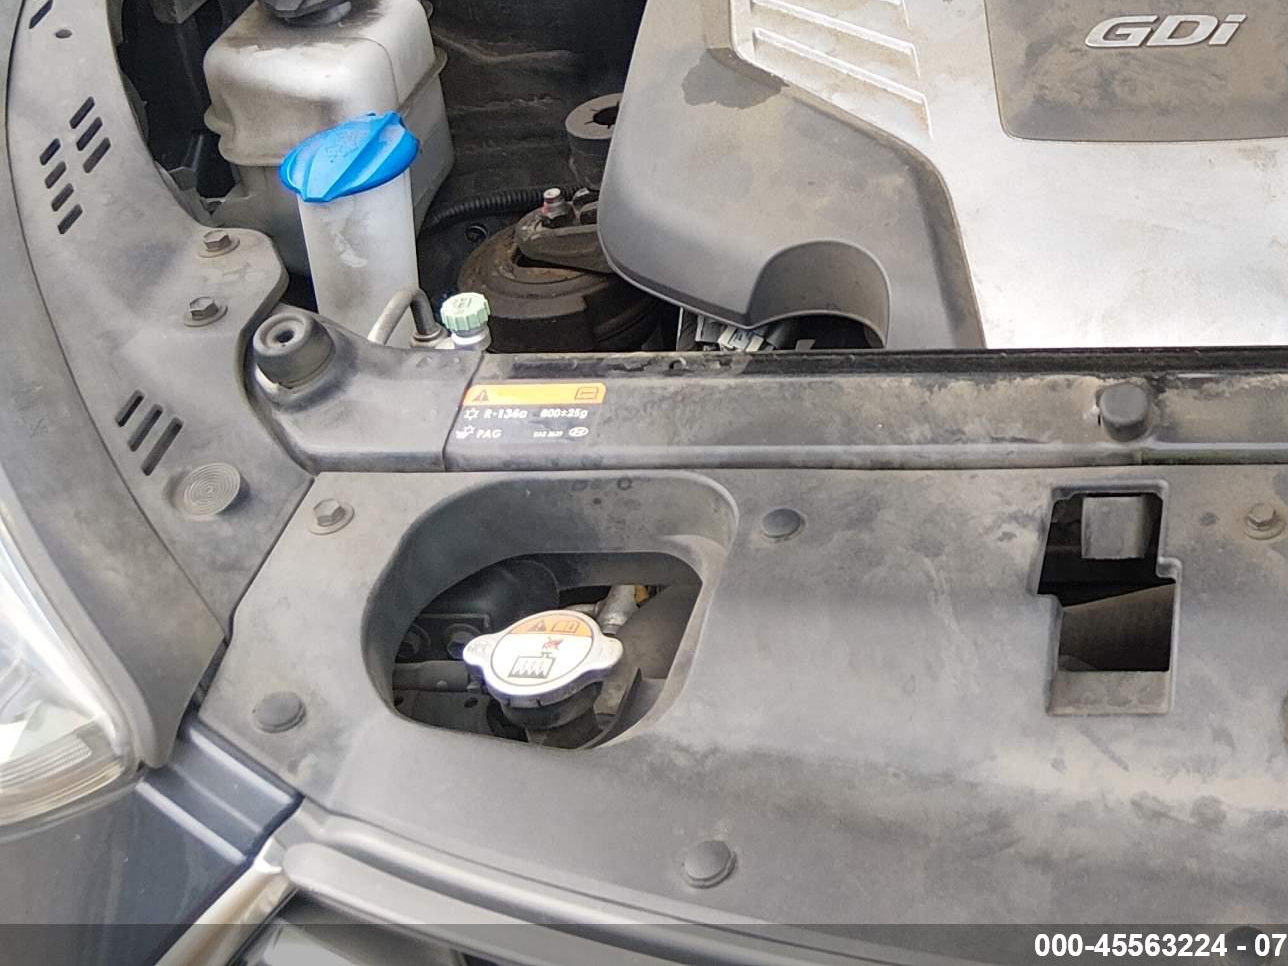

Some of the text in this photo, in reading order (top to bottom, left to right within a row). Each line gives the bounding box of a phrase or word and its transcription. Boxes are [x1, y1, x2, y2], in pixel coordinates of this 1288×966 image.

[1085, 13, 1248, 48] GDi
[483, 408, 528, 419] R-134a
[476, 428, 502, 439] PAG
